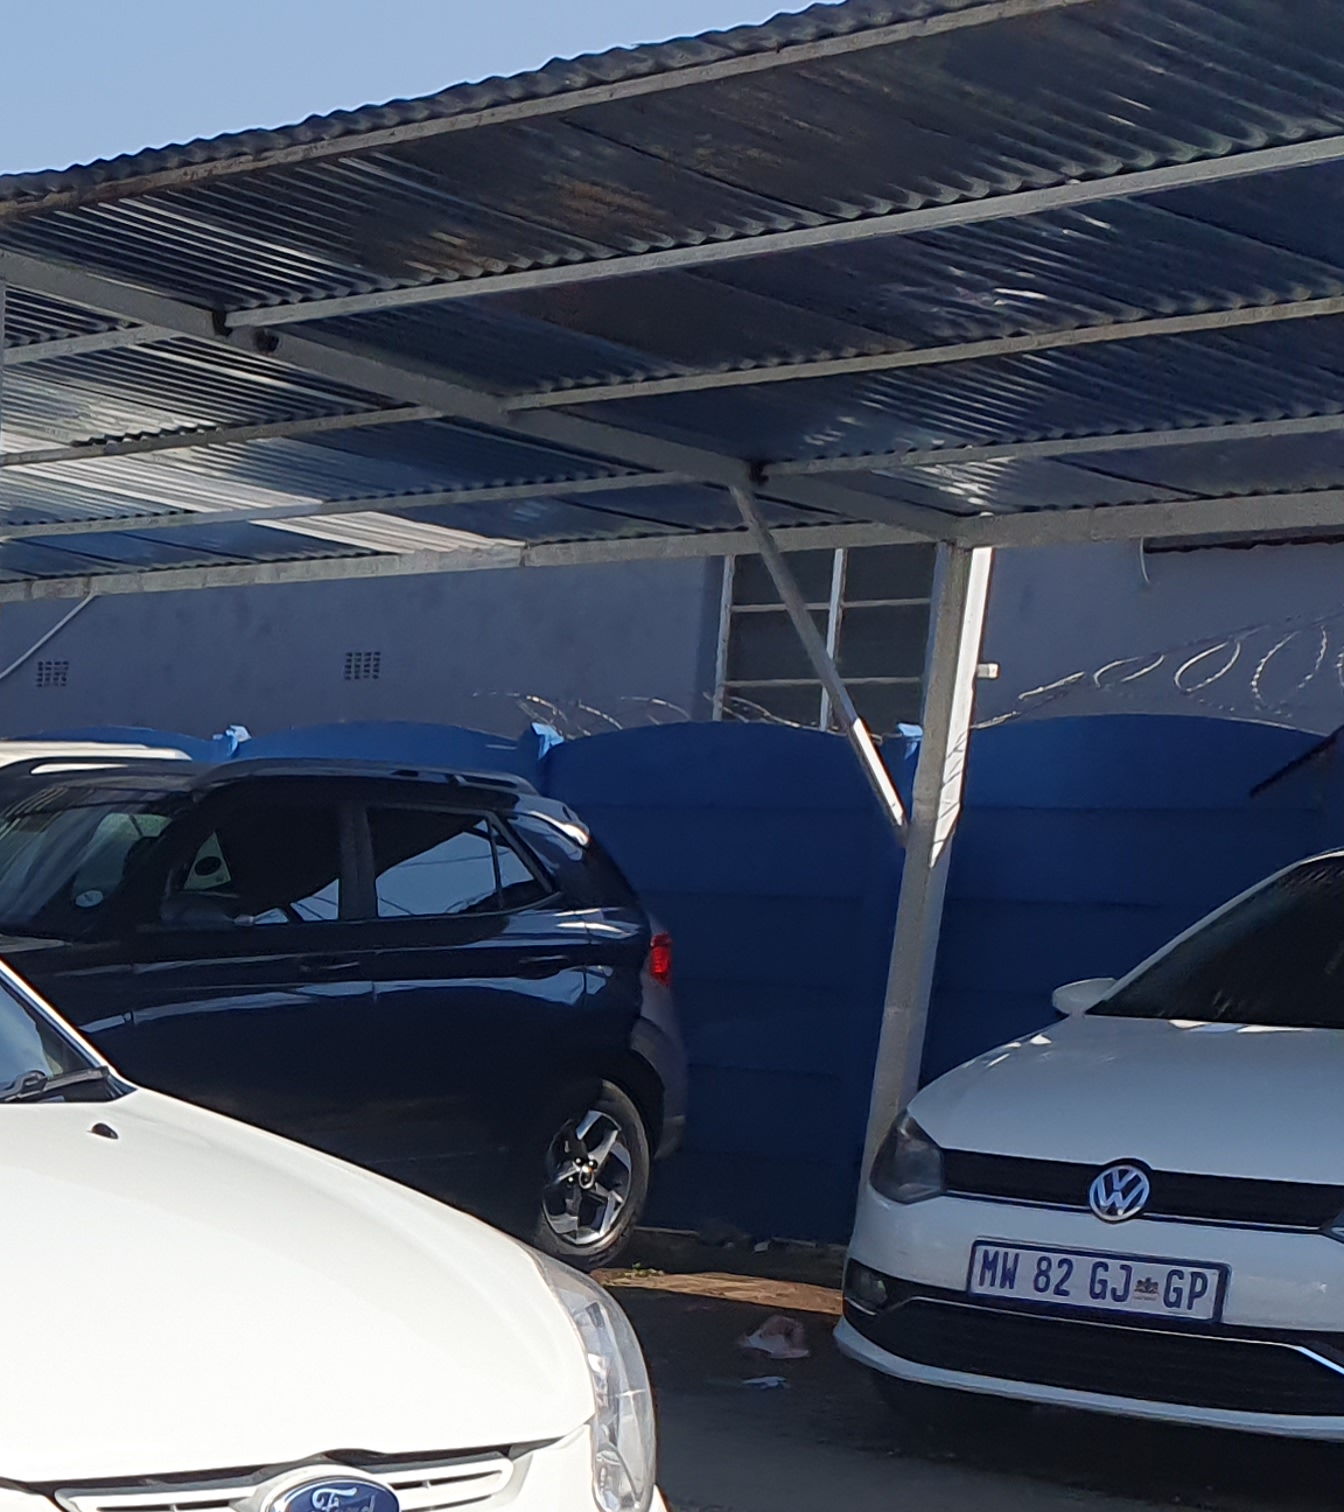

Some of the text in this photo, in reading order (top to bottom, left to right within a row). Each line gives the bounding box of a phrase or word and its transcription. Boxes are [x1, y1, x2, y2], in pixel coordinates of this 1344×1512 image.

[978, 1249, 1209, 1311] MW 82 GJ GP
